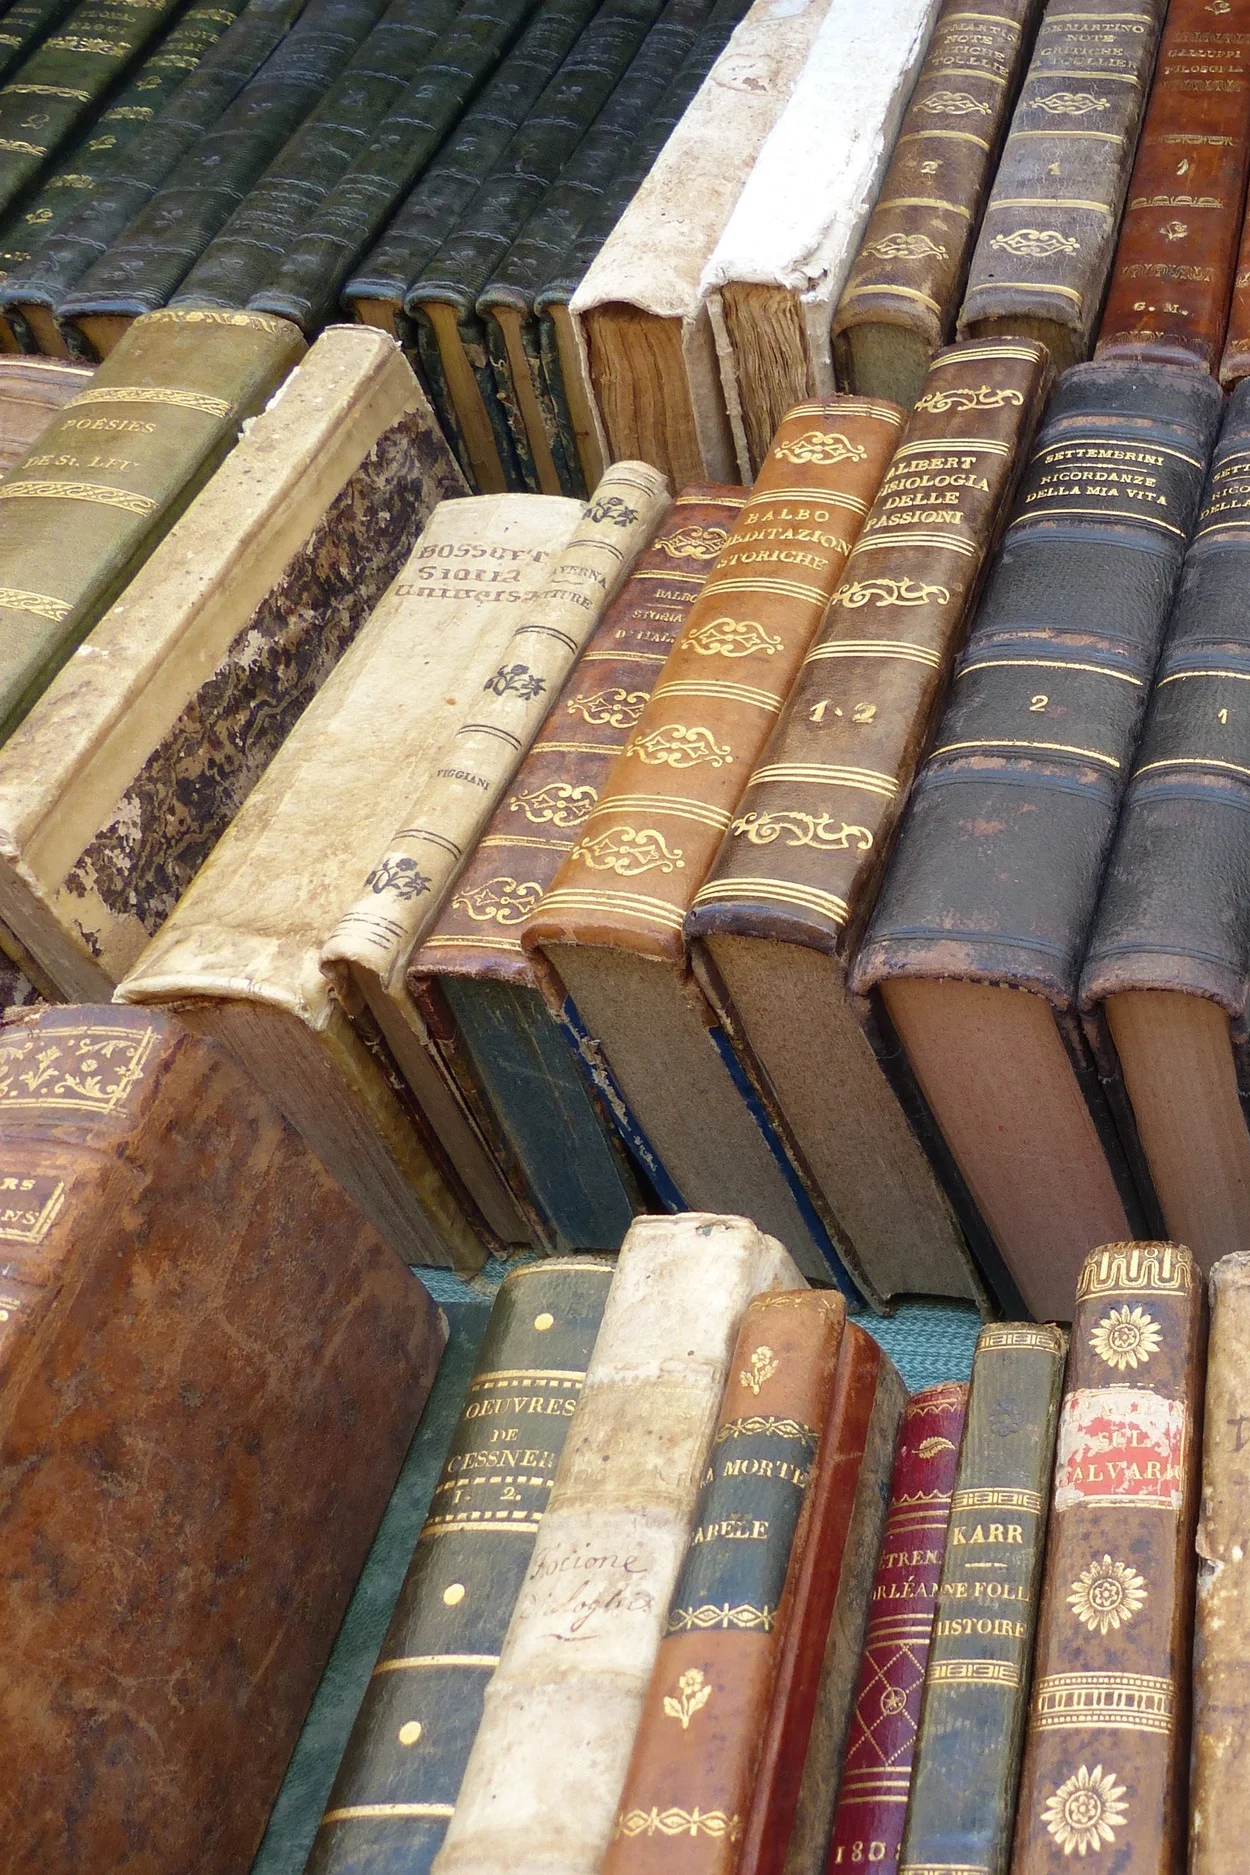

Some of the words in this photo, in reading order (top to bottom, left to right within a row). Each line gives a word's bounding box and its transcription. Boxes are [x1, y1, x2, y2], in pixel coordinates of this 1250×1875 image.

[1065, 23, 1144, 34] MARTINO
[944, 35, 993, 45] NOTE
[1065, 34, 1117, 43] NOTE
[1041, 46, 1124, 56] CRITICHE
[1044, 448, 1164, 466] SETTEMBRINI
[883, 456, 977, 482] ALIBERT
[1040, 471, 1157, 488] RICORDANZE
[883, 492, 960, 510] DELLE
[1025, 486, 1082, 505] DELLA
[1086, 485, 1119, 497] MIA
[1125, 490, 1169, 507] VITA
[745, 508, 830, 525] BALBO
[863, 510, 964, 533] PASSIONI
[717, 550, 830, 571] STORICHE
[632, 610, 683, 623] STORIA
[1029, 695, 1049, 712] 2
[1217, 708, 1229, 725] 1
[464, 1397, 577, 1420] OEUVRES
[491, 1428, 519, 1443] DE
[723, 1458, 810, 1489] MORTE
[952, 1523, 1024, 1546] KARR
